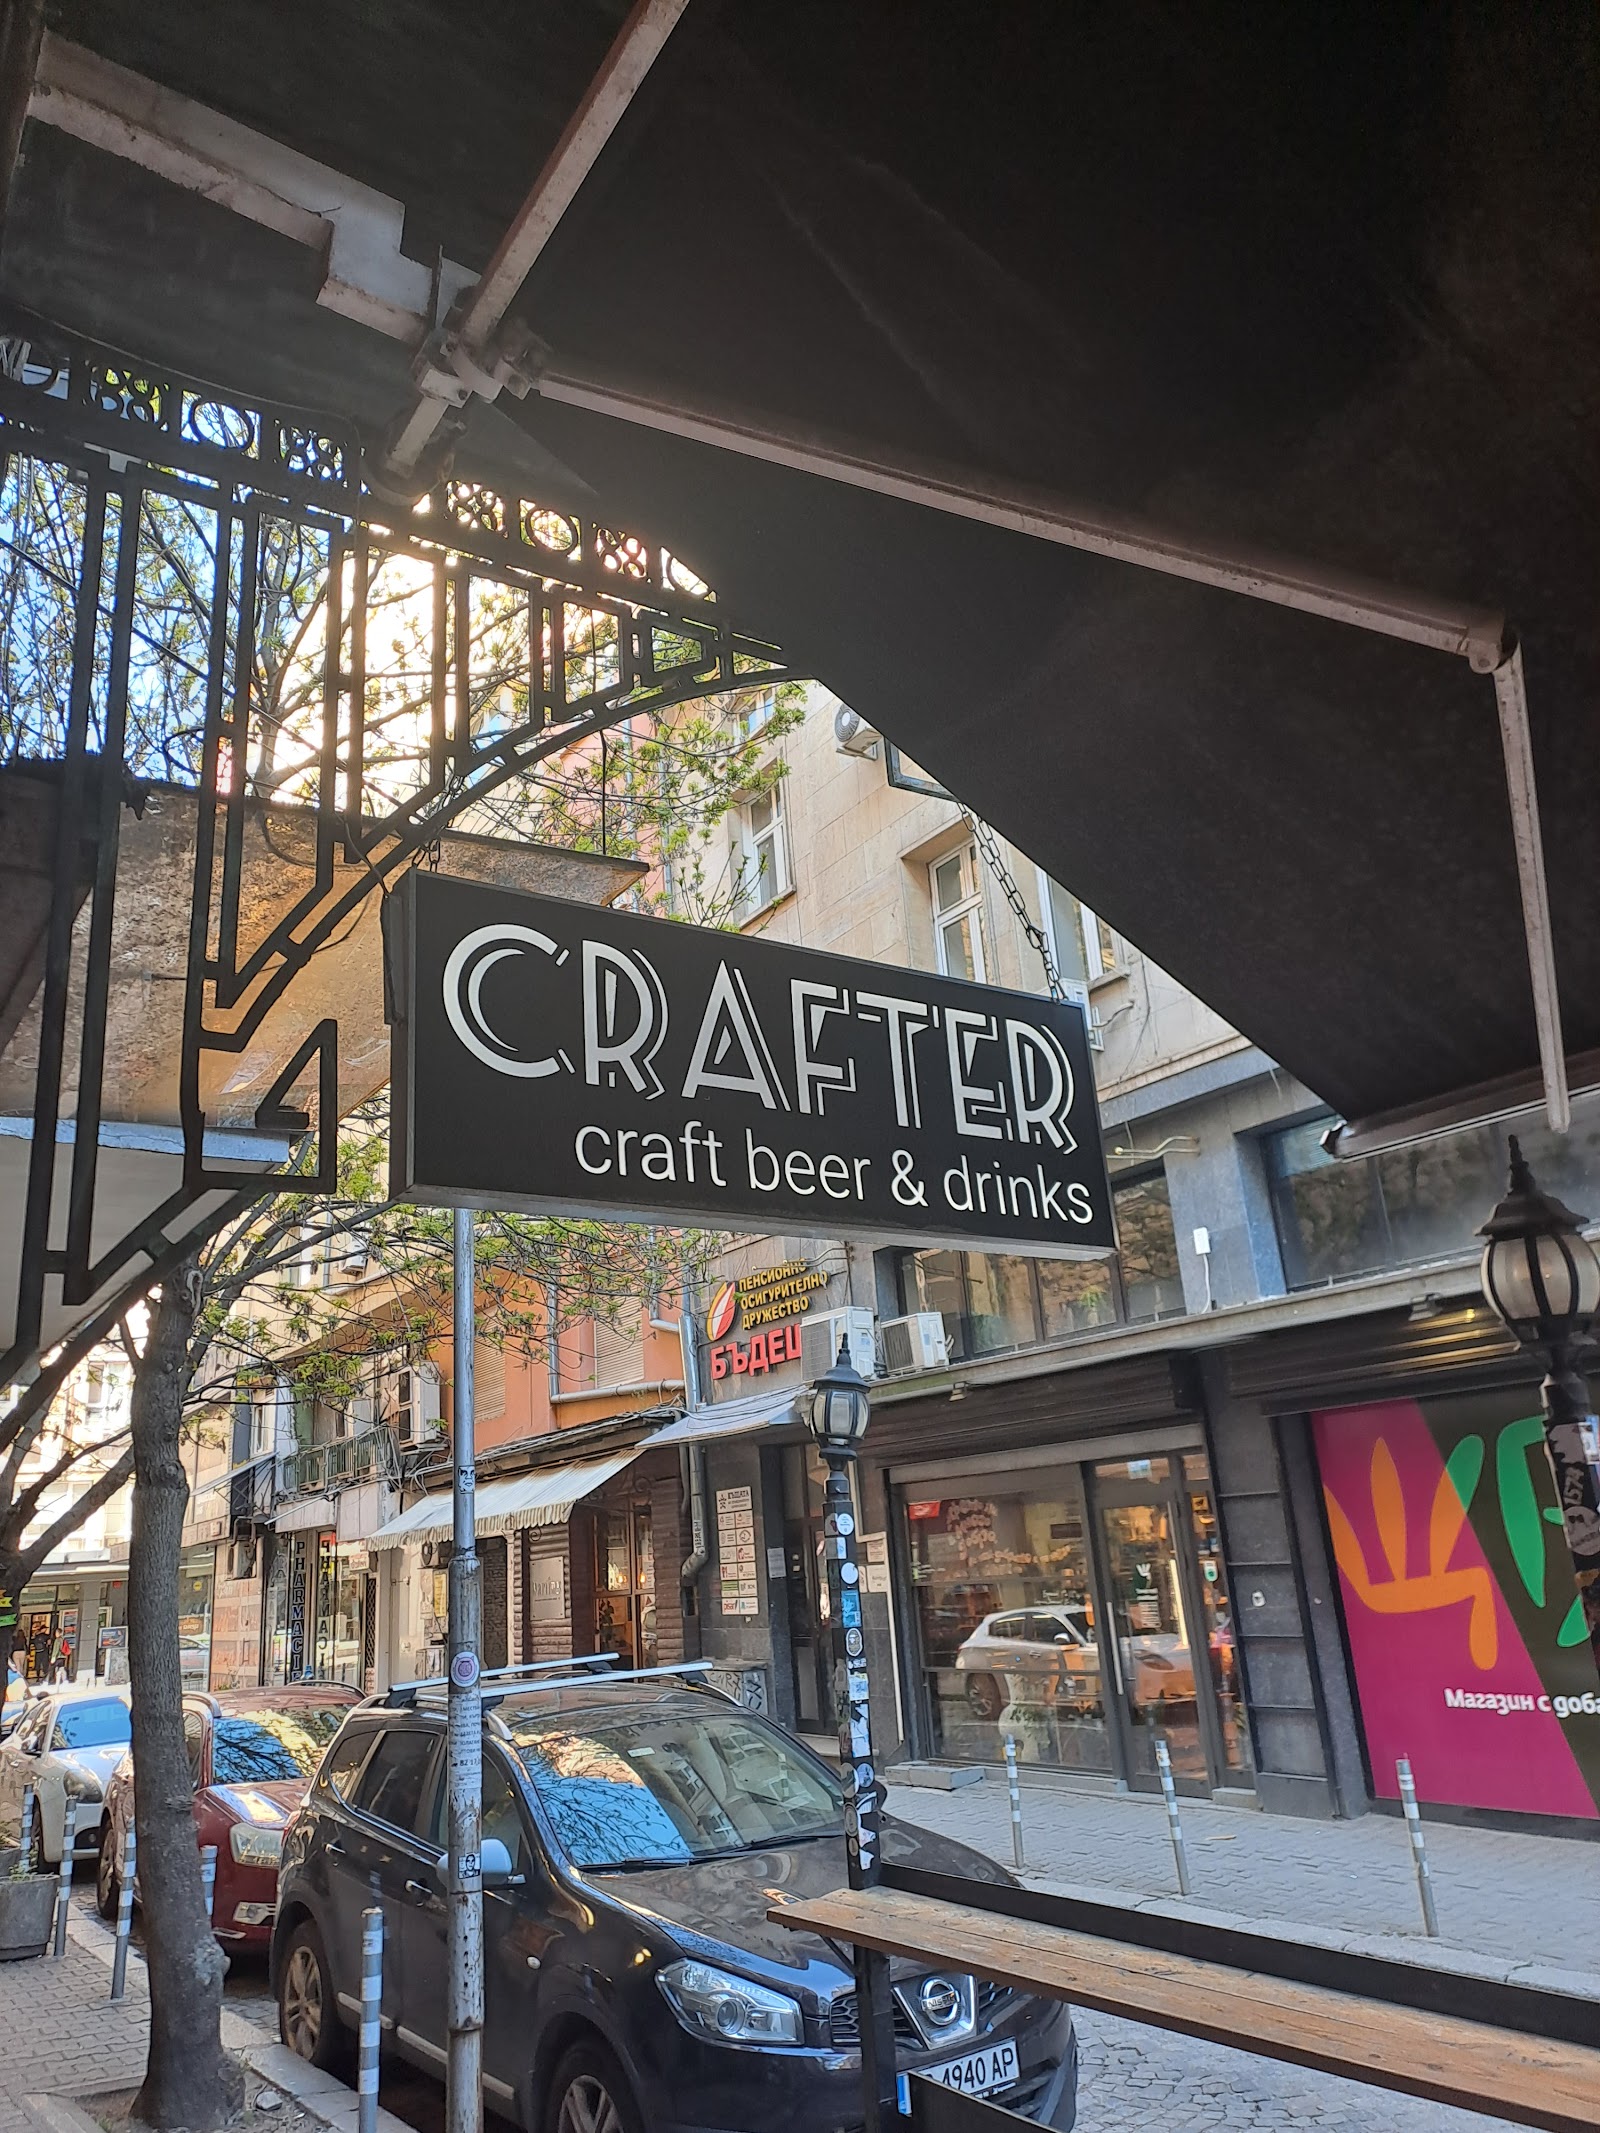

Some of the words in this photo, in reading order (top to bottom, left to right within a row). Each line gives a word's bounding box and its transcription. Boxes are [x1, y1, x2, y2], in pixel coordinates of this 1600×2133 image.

[441, 923, 1078, 1155] CRAFTER
[574, 1120, 726, 1188] craft
[744, 1127, 873, 1200] beer
[890, 1148, 929, 1208] &
[943, 1154, 1094, 1226] drinks
[739, 1258, 807, 1293] ПЕНСИОННО
[740, 1270, 829, 1310] ОСИГУРИТЕЛНО
[742, 1295, 810, 1330] ДРУЖЕСТВО
[1443, 1687, 1536, 1716] Магазин
[1537, 1695, 1552, 1713] с
[992, 2047, 1014, 2081] AP
